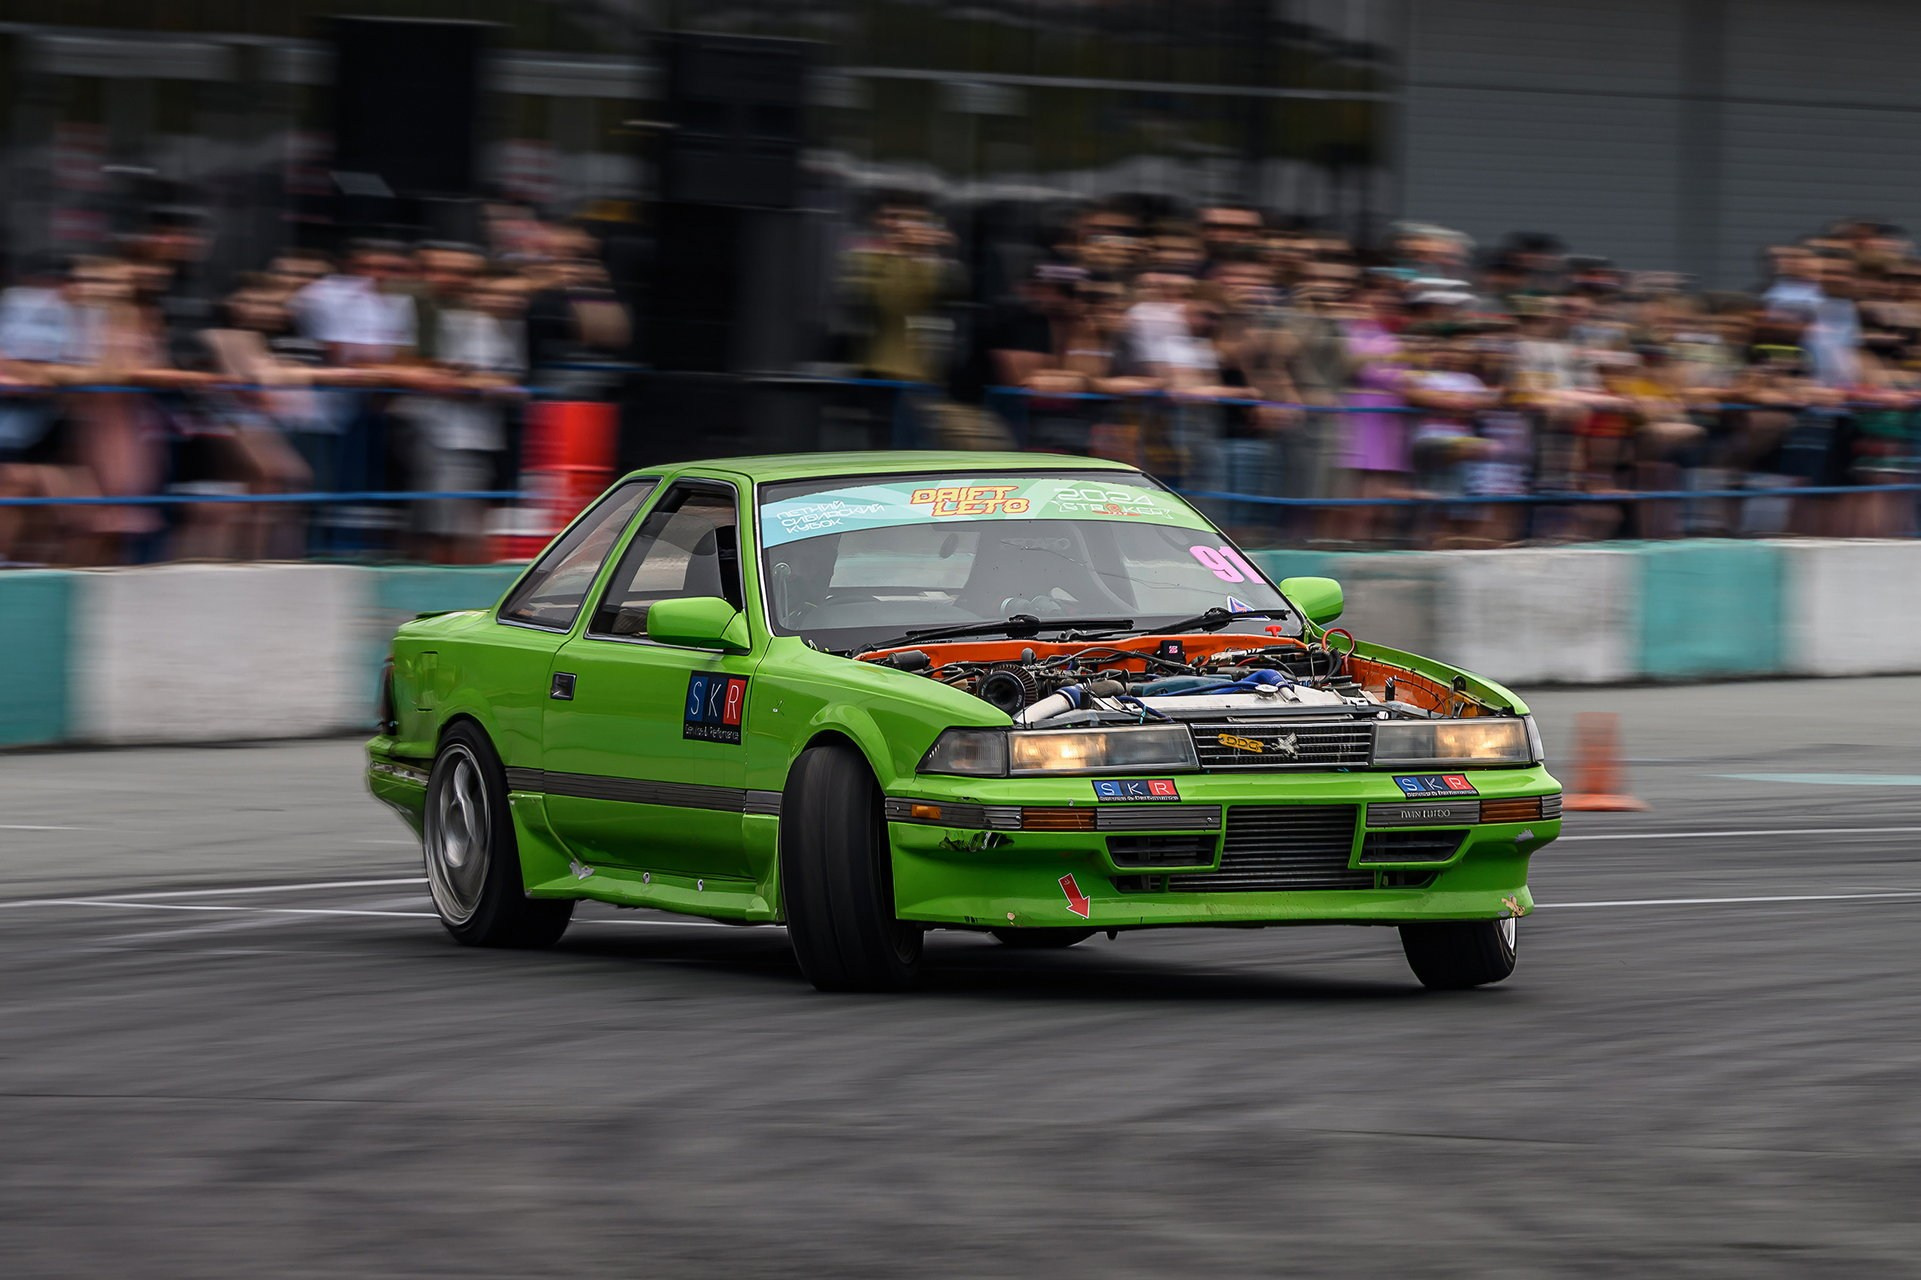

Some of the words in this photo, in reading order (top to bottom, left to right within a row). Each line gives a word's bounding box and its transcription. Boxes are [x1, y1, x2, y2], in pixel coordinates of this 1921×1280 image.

[910, 486, 1019, 504] DRIFT
[1054, 488, 1154, 506] 2024
[932, 498, 1030, 516] LETO
[1189, 545, 1267, 584] 91
[690, 681, 740, 719] SKR
[1101, 782, 1170, 795] SKR
